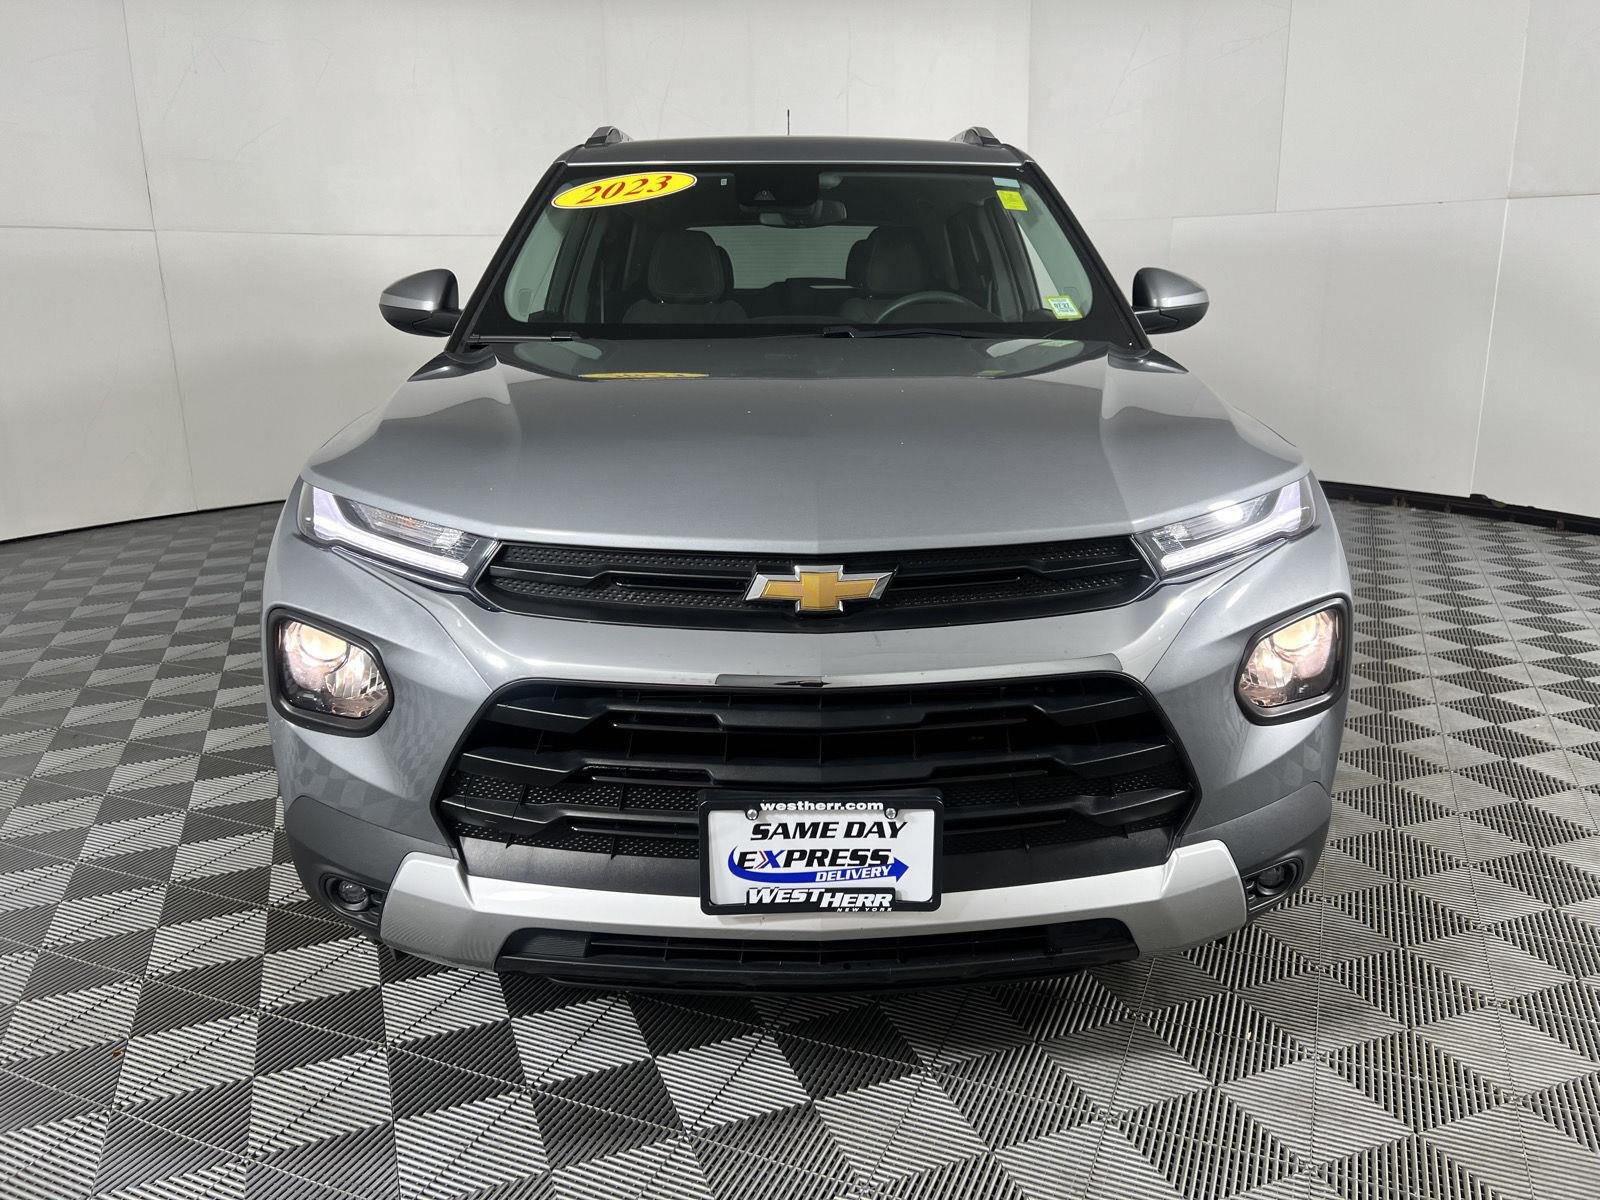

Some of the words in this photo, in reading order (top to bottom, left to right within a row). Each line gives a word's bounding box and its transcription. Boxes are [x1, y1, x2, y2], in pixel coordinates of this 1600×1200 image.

[576, 175, 672, 204] 2023
[760, 801, 884, 811] westherr.com
[750, 821, 839, 840] SAME
[843, 821, 908, 839] DAY
[736, 848, 892, 869] EXPRESS
[815, 864, 892, 882] DELIVERY
